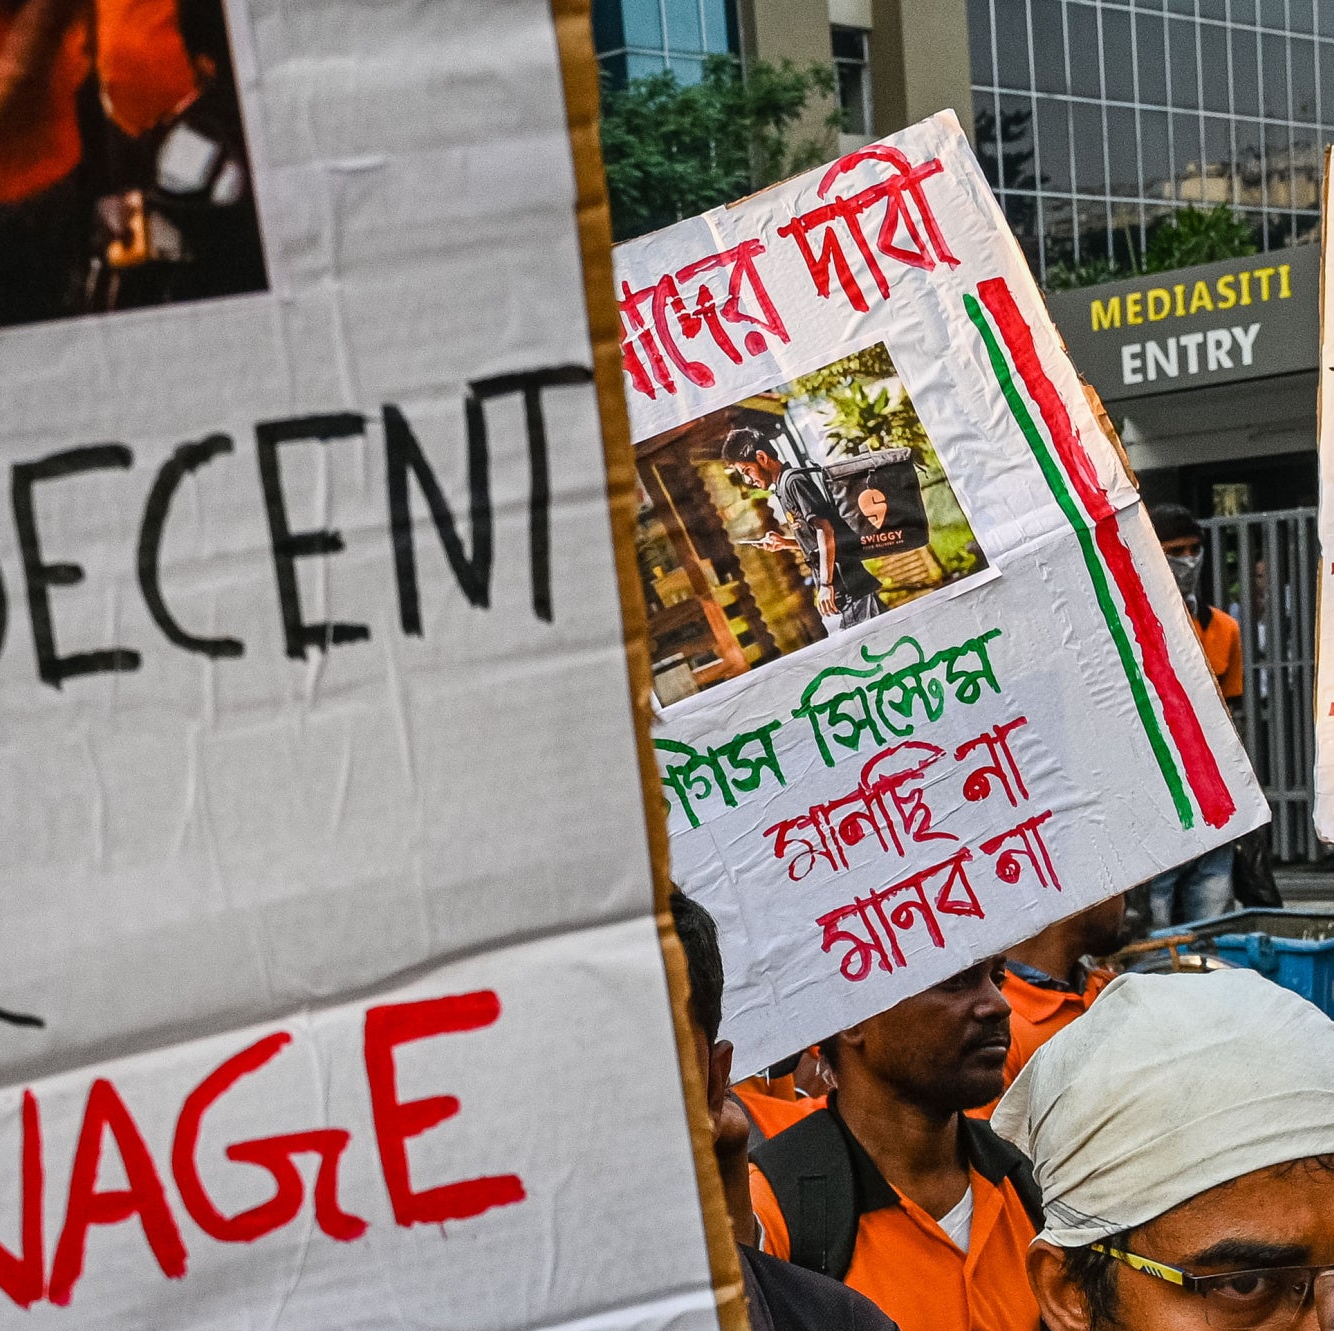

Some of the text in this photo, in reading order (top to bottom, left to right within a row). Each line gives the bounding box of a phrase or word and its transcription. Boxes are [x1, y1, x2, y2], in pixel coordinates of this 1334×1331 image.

[777, 144, 962, 313] দাবী
[1090, 263, 1292, 332] MEDIASITI
[1120, 322, 1262, 386] ENTRY
[860, 530, 903, 546] SWIGGY
[953, 715, 1028, 807] না
[978, 809, 1062, 892] না
